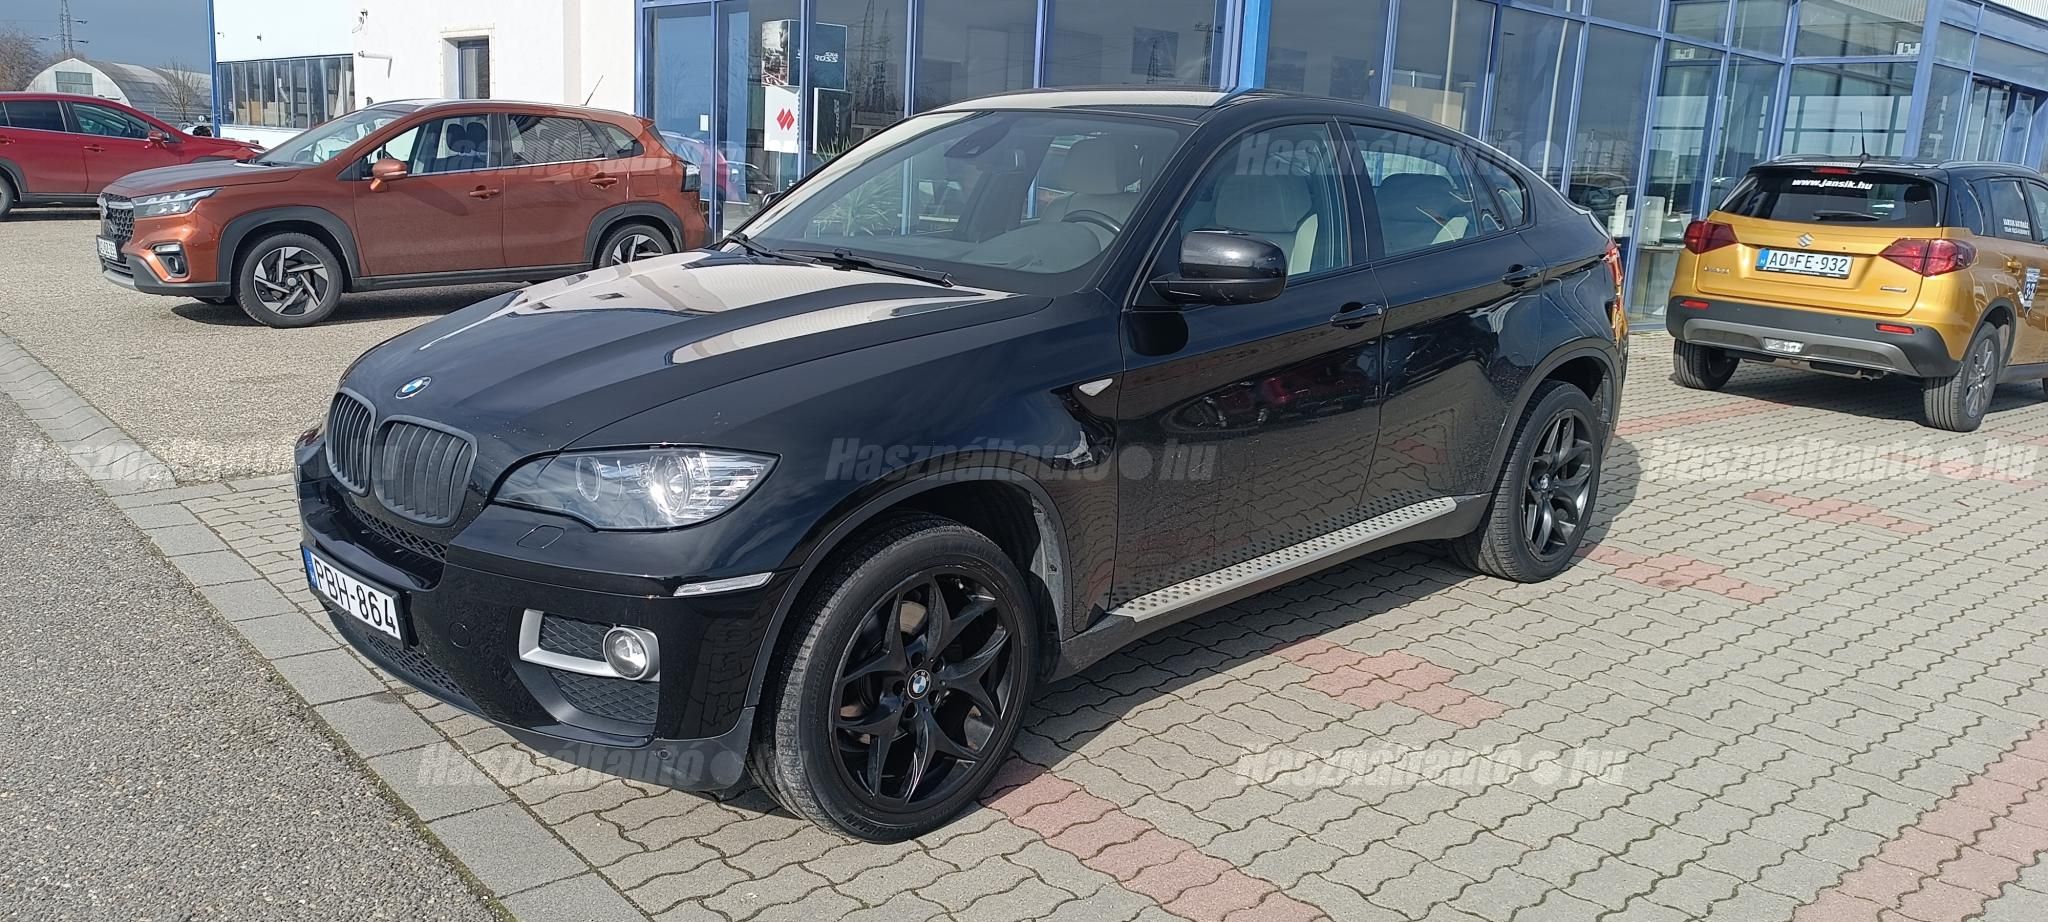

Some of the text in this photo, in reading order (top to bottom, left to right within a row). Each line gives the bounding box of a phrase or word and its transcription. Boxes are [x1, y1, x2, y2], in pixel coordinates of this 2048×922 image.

[1791, 178, 1873, 190] www.jansik.hu
[1769, 252, 1789, 267] AO
[313, 558, 396, 634] PBH-864
